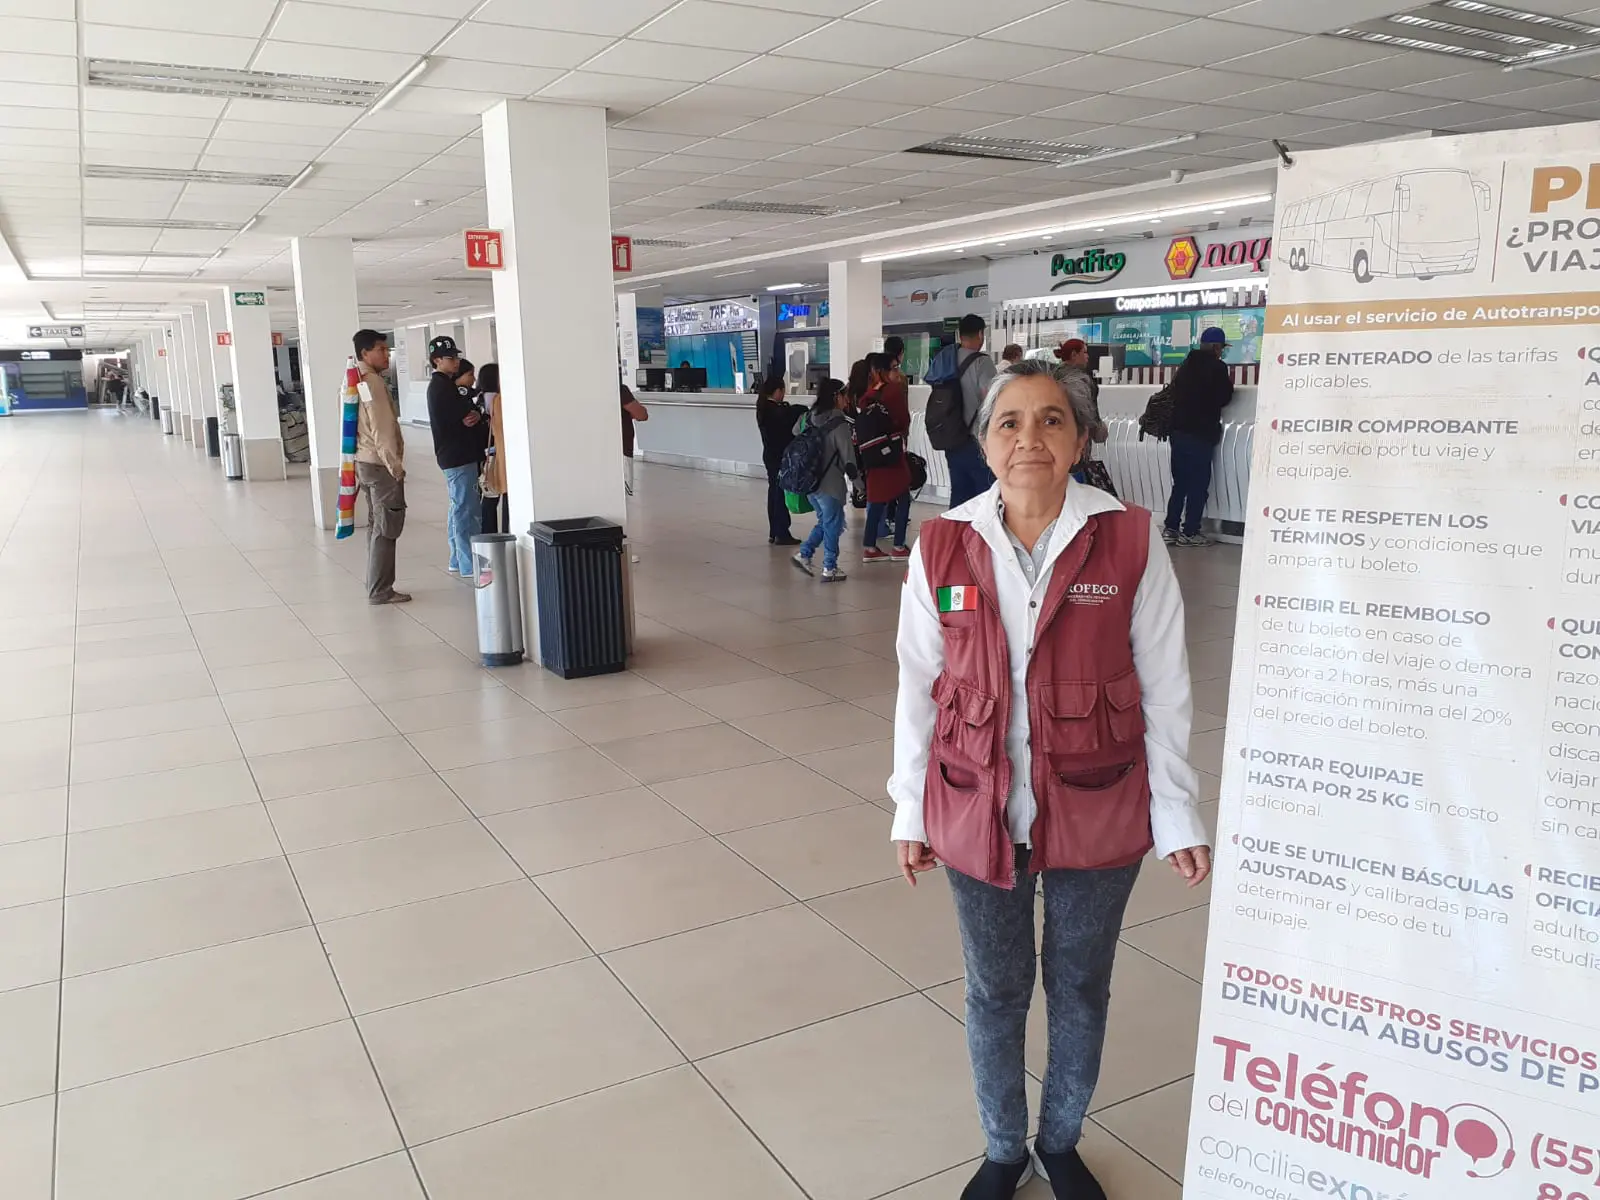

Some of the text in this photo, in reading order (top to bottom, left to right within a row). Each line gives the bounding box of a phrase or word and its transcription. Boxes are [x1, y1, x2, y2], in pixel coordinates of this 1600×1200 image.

[1506, 217, 1600, 249] ¿PRO
[1201, 237, 1272, 272] nay
[1177, 292, 1198, 306] Las
[1281, 303, 1600, 326] Al usar el servicio de Autotranspo
[44, 328, 69, 336] TAXIS
[1287, 347, 1558, 366] SER ENTERADO de las tarifas
[1284, 373, 1372, 391] aplicables.
[1281, 419, 1518, 434] RECIBIR COMPROBANTE
[1279, 442, 1495, 461] del servicio por tu viaje y
[1277, 464, 1351, 479] equipaje.
[1273, 507, 1488, 529] QUE TE RESPETEN LOS
[1270, 527, 1542, 559] TÉRMINOS y condiciones que
[1268, 553, 1420, 574] ampara tu boleto.
[1264, 595, 1490, 626] RECIBIR EL REEMBOLSO
[1262, 617, 1462, 647] de tu boleto en caso de
[1259, 640, 1532, 679] cancelación del viaje o demora
[1258, 663, 1477, 698] mayor a 2 horas, más una
[1256, 682, 1512, 726] bonificación mínima del 20%
[1253, 704, 1428, 740] del precio del boleto.
[1250, 749, 1423, 787] PORTAR EQUIPAJE
[1246, 794, 1324, 817] adicional.
[1248, 771, 1498, 823] HASTA POR 25 KG sin costo
[1541, 817, 1569, 834] sin
[1242, 836, 1513, 900] QUE SE UTILICEN BÁSCULAS
[1239, 859, 1508, 924] AJUSTADAS y calibradas para
[1235, 904, 1310, 931] equipaje.
[1237, 881, 1451, 937] determinar el peso de tu
[1224, 962, 1597, 1070] TODOS NUESTROS SERVICIOS
[1222, 981, 1368, 1036] DENUNCIA
[1379, 1022, 1508, 1072] ABUSOS
[1520, 1058, 1566, 1088] DE
[1208, 1092, 1441, 1179] del consumidor
